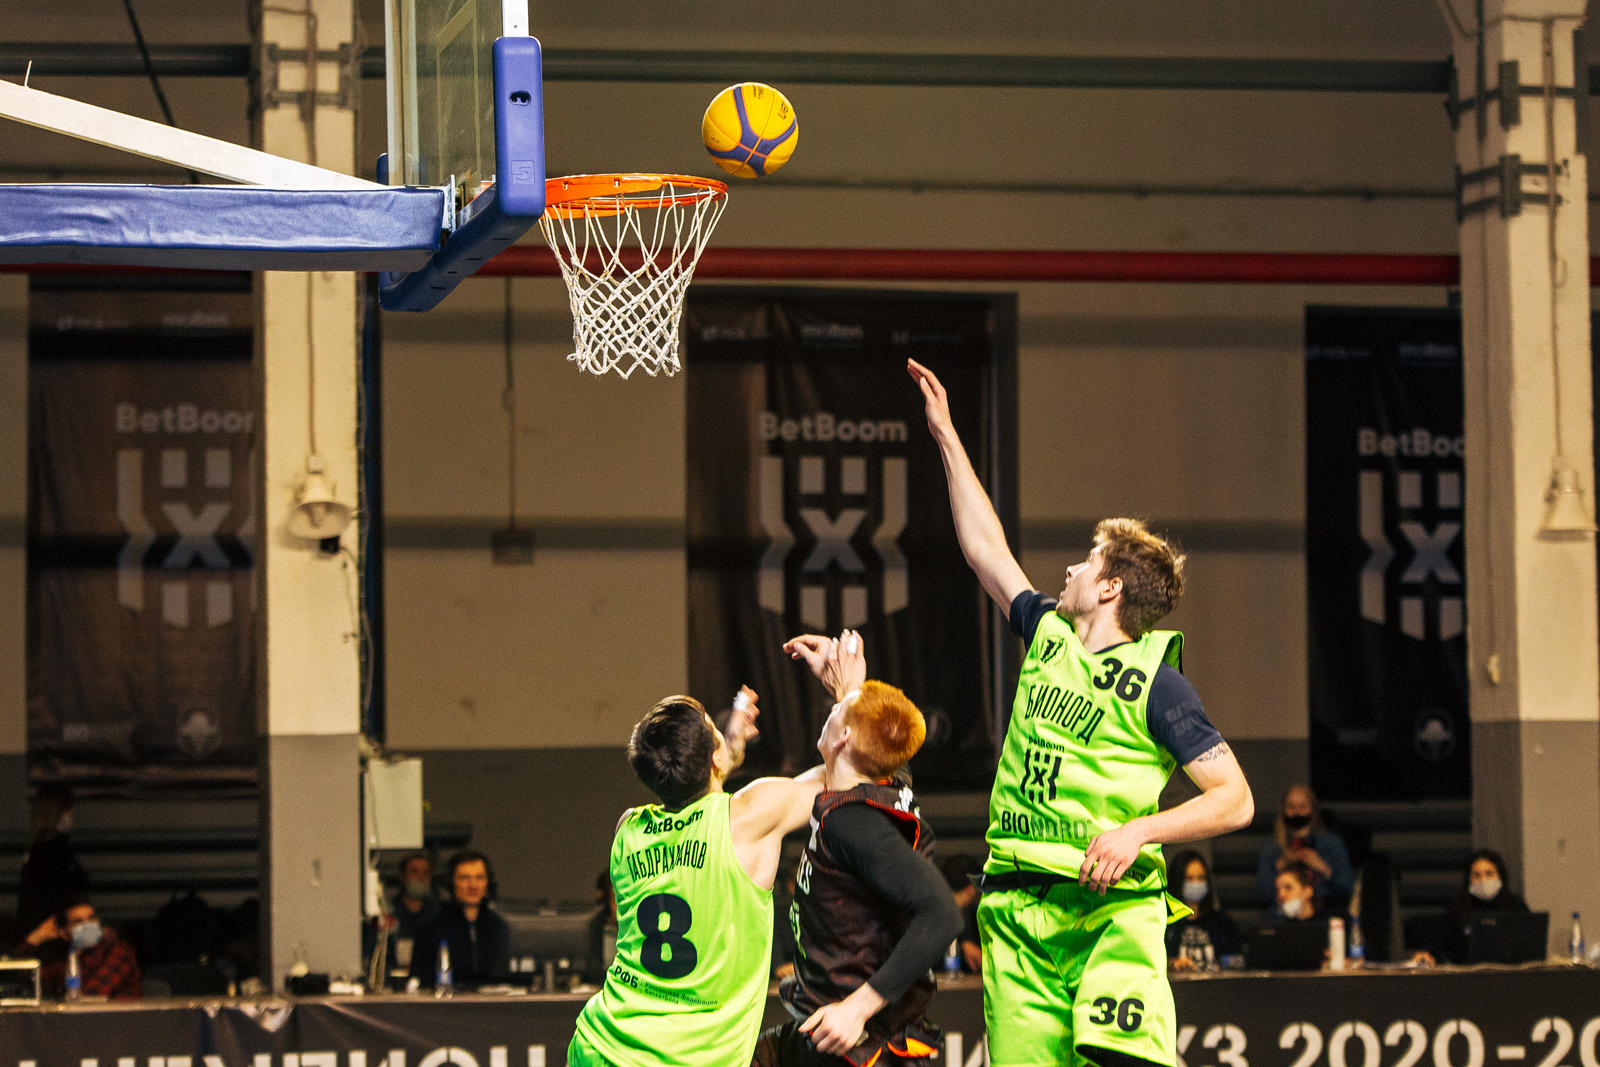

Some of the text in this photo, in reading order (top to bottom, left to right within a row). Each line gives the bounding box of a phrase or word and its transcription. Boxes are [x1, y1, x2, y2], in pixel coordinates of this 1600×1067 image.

[116, 404, 255, 433] BetBoo
[758, 412, 908, 442] BetBoom
[1357, 428, 1464, 457] BetBoo
[1093, 658, 1147, 702] 36
[1025, 684, 1105, 745] БИОНОРД
[643, 810, 703, 834] BetBoom
[1001, 810, 1087, 840] BIONORD
[637, 893, 698, 979] 8
[614, 965, 639, 989] РФБ
[1089, 997, 1144, 1032] 36
